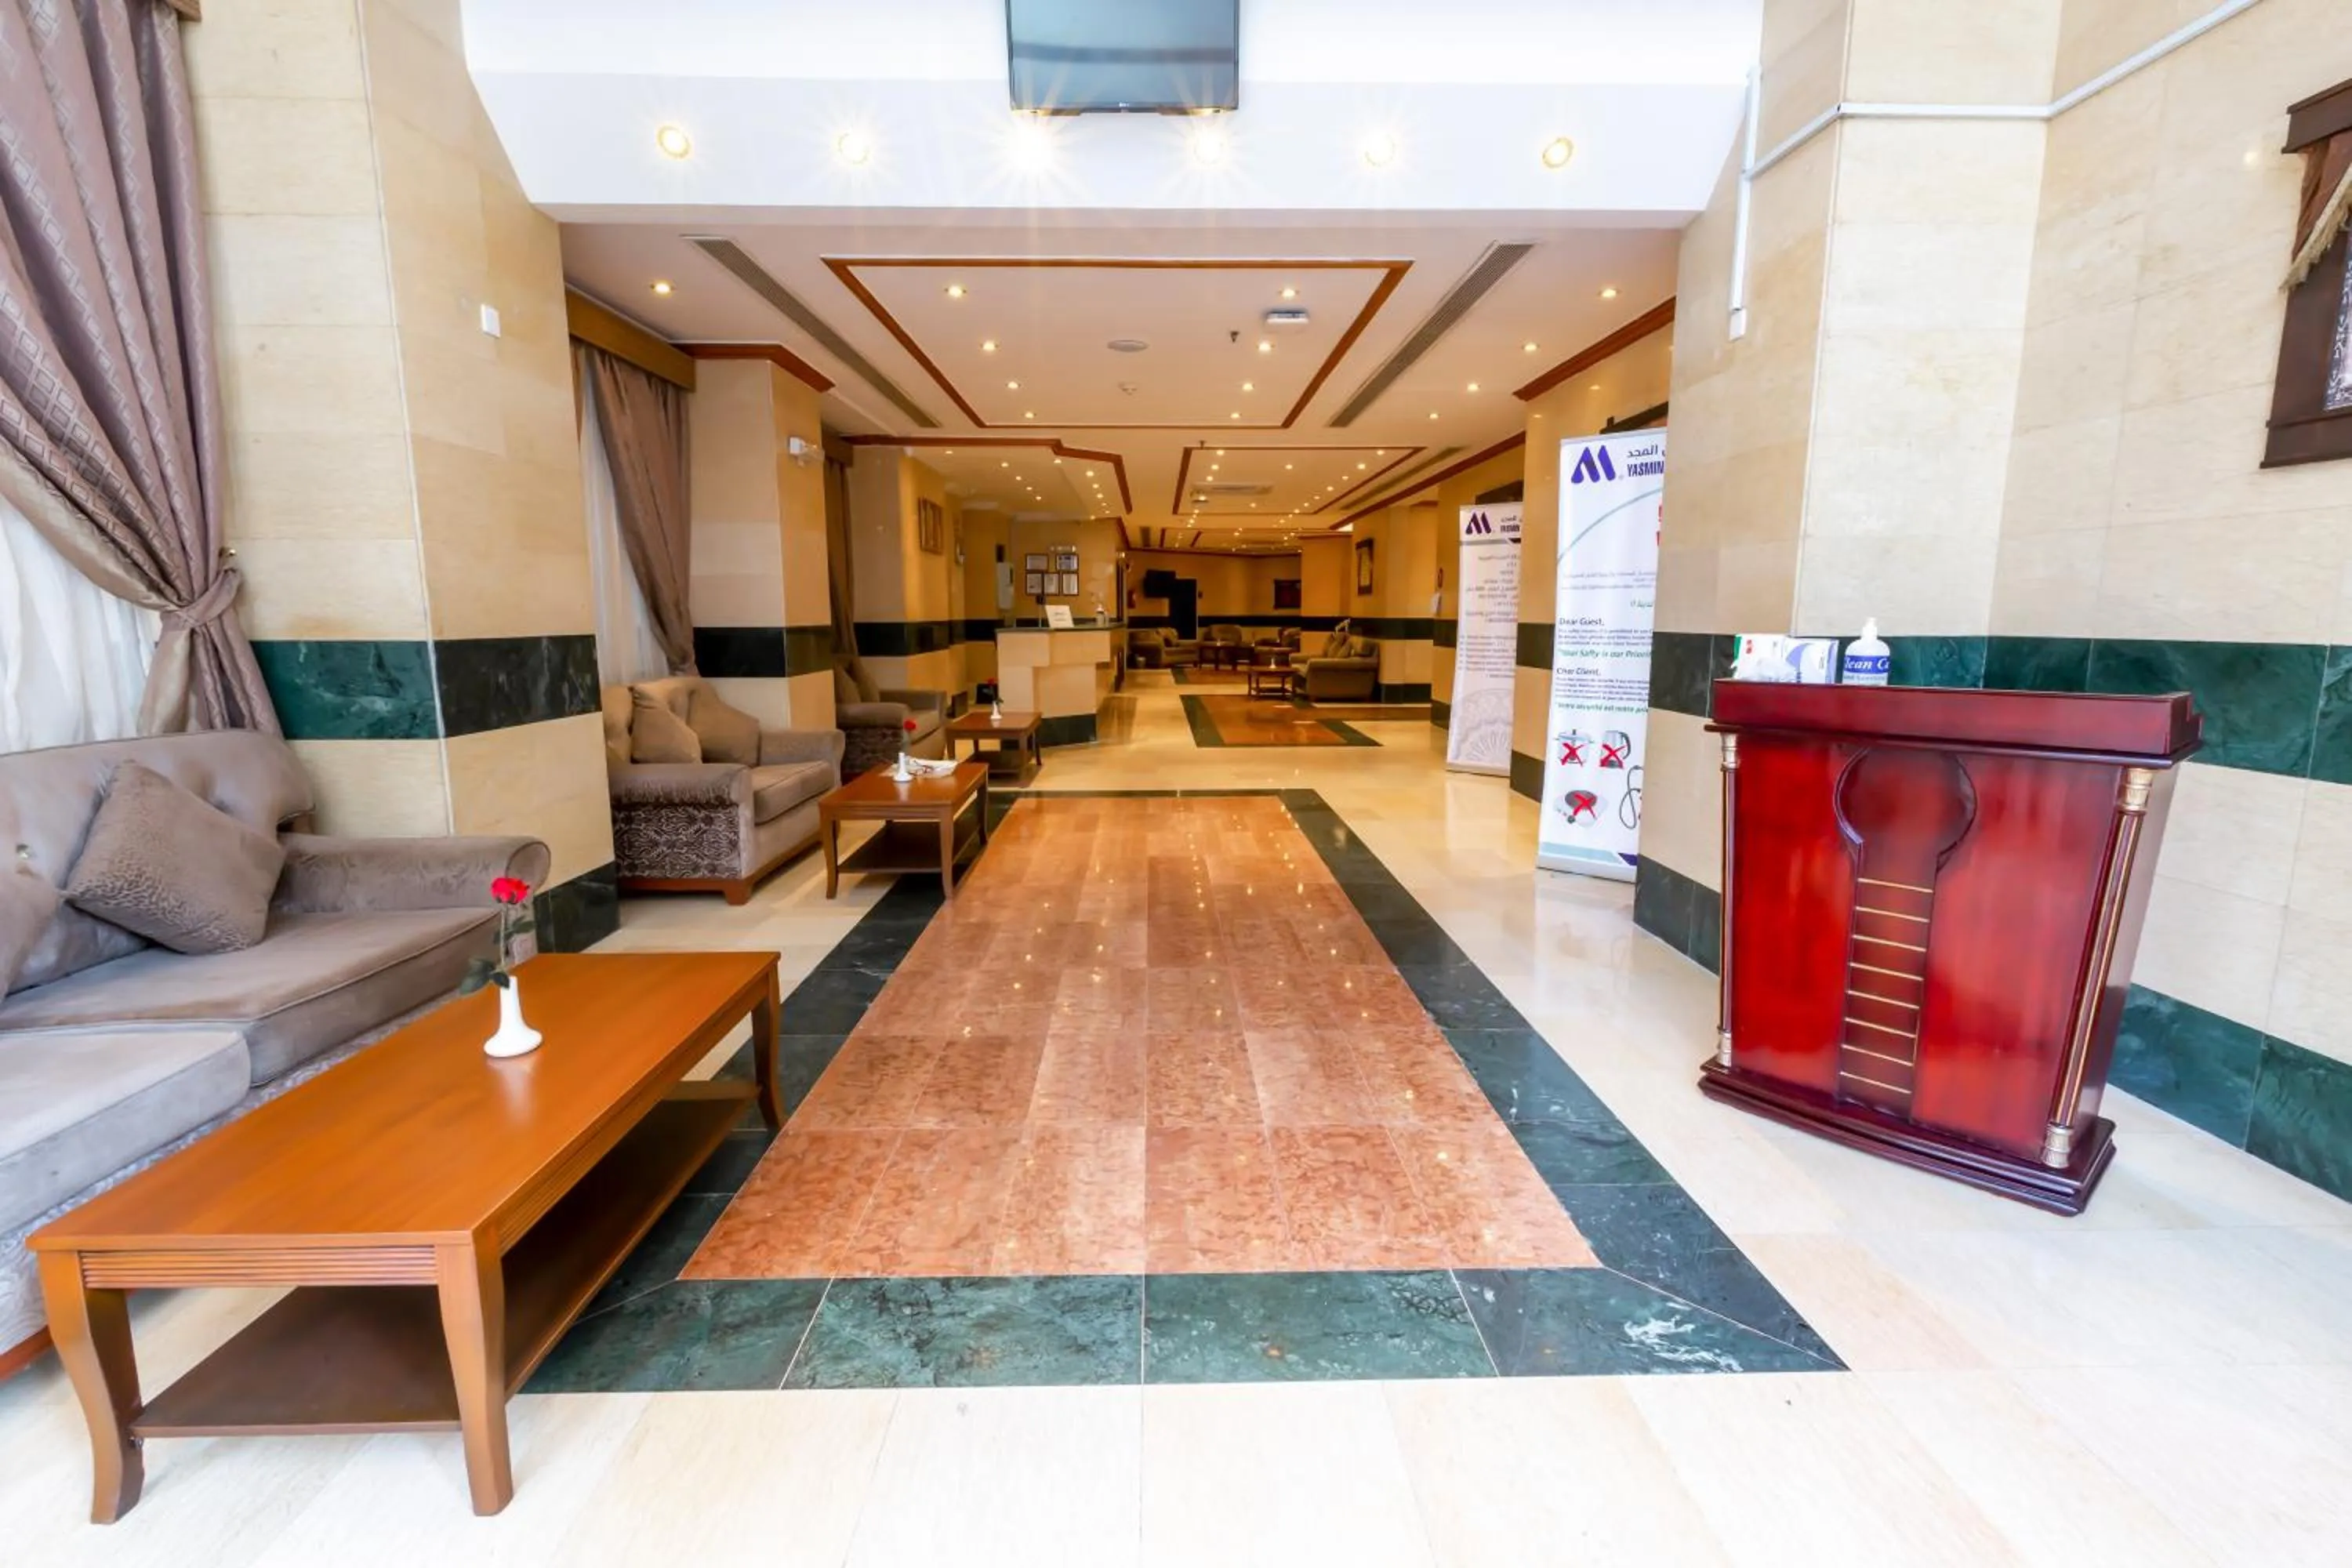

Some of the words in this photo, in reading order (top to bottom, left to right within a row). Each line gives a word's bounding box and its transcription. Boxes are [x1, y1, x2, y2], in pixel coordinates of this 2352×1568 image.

[1628, 445, 1658, 459] المجد
[1627, 461, 1664, 477] YASMIN
[1845, 657, 1872, 670] lean
